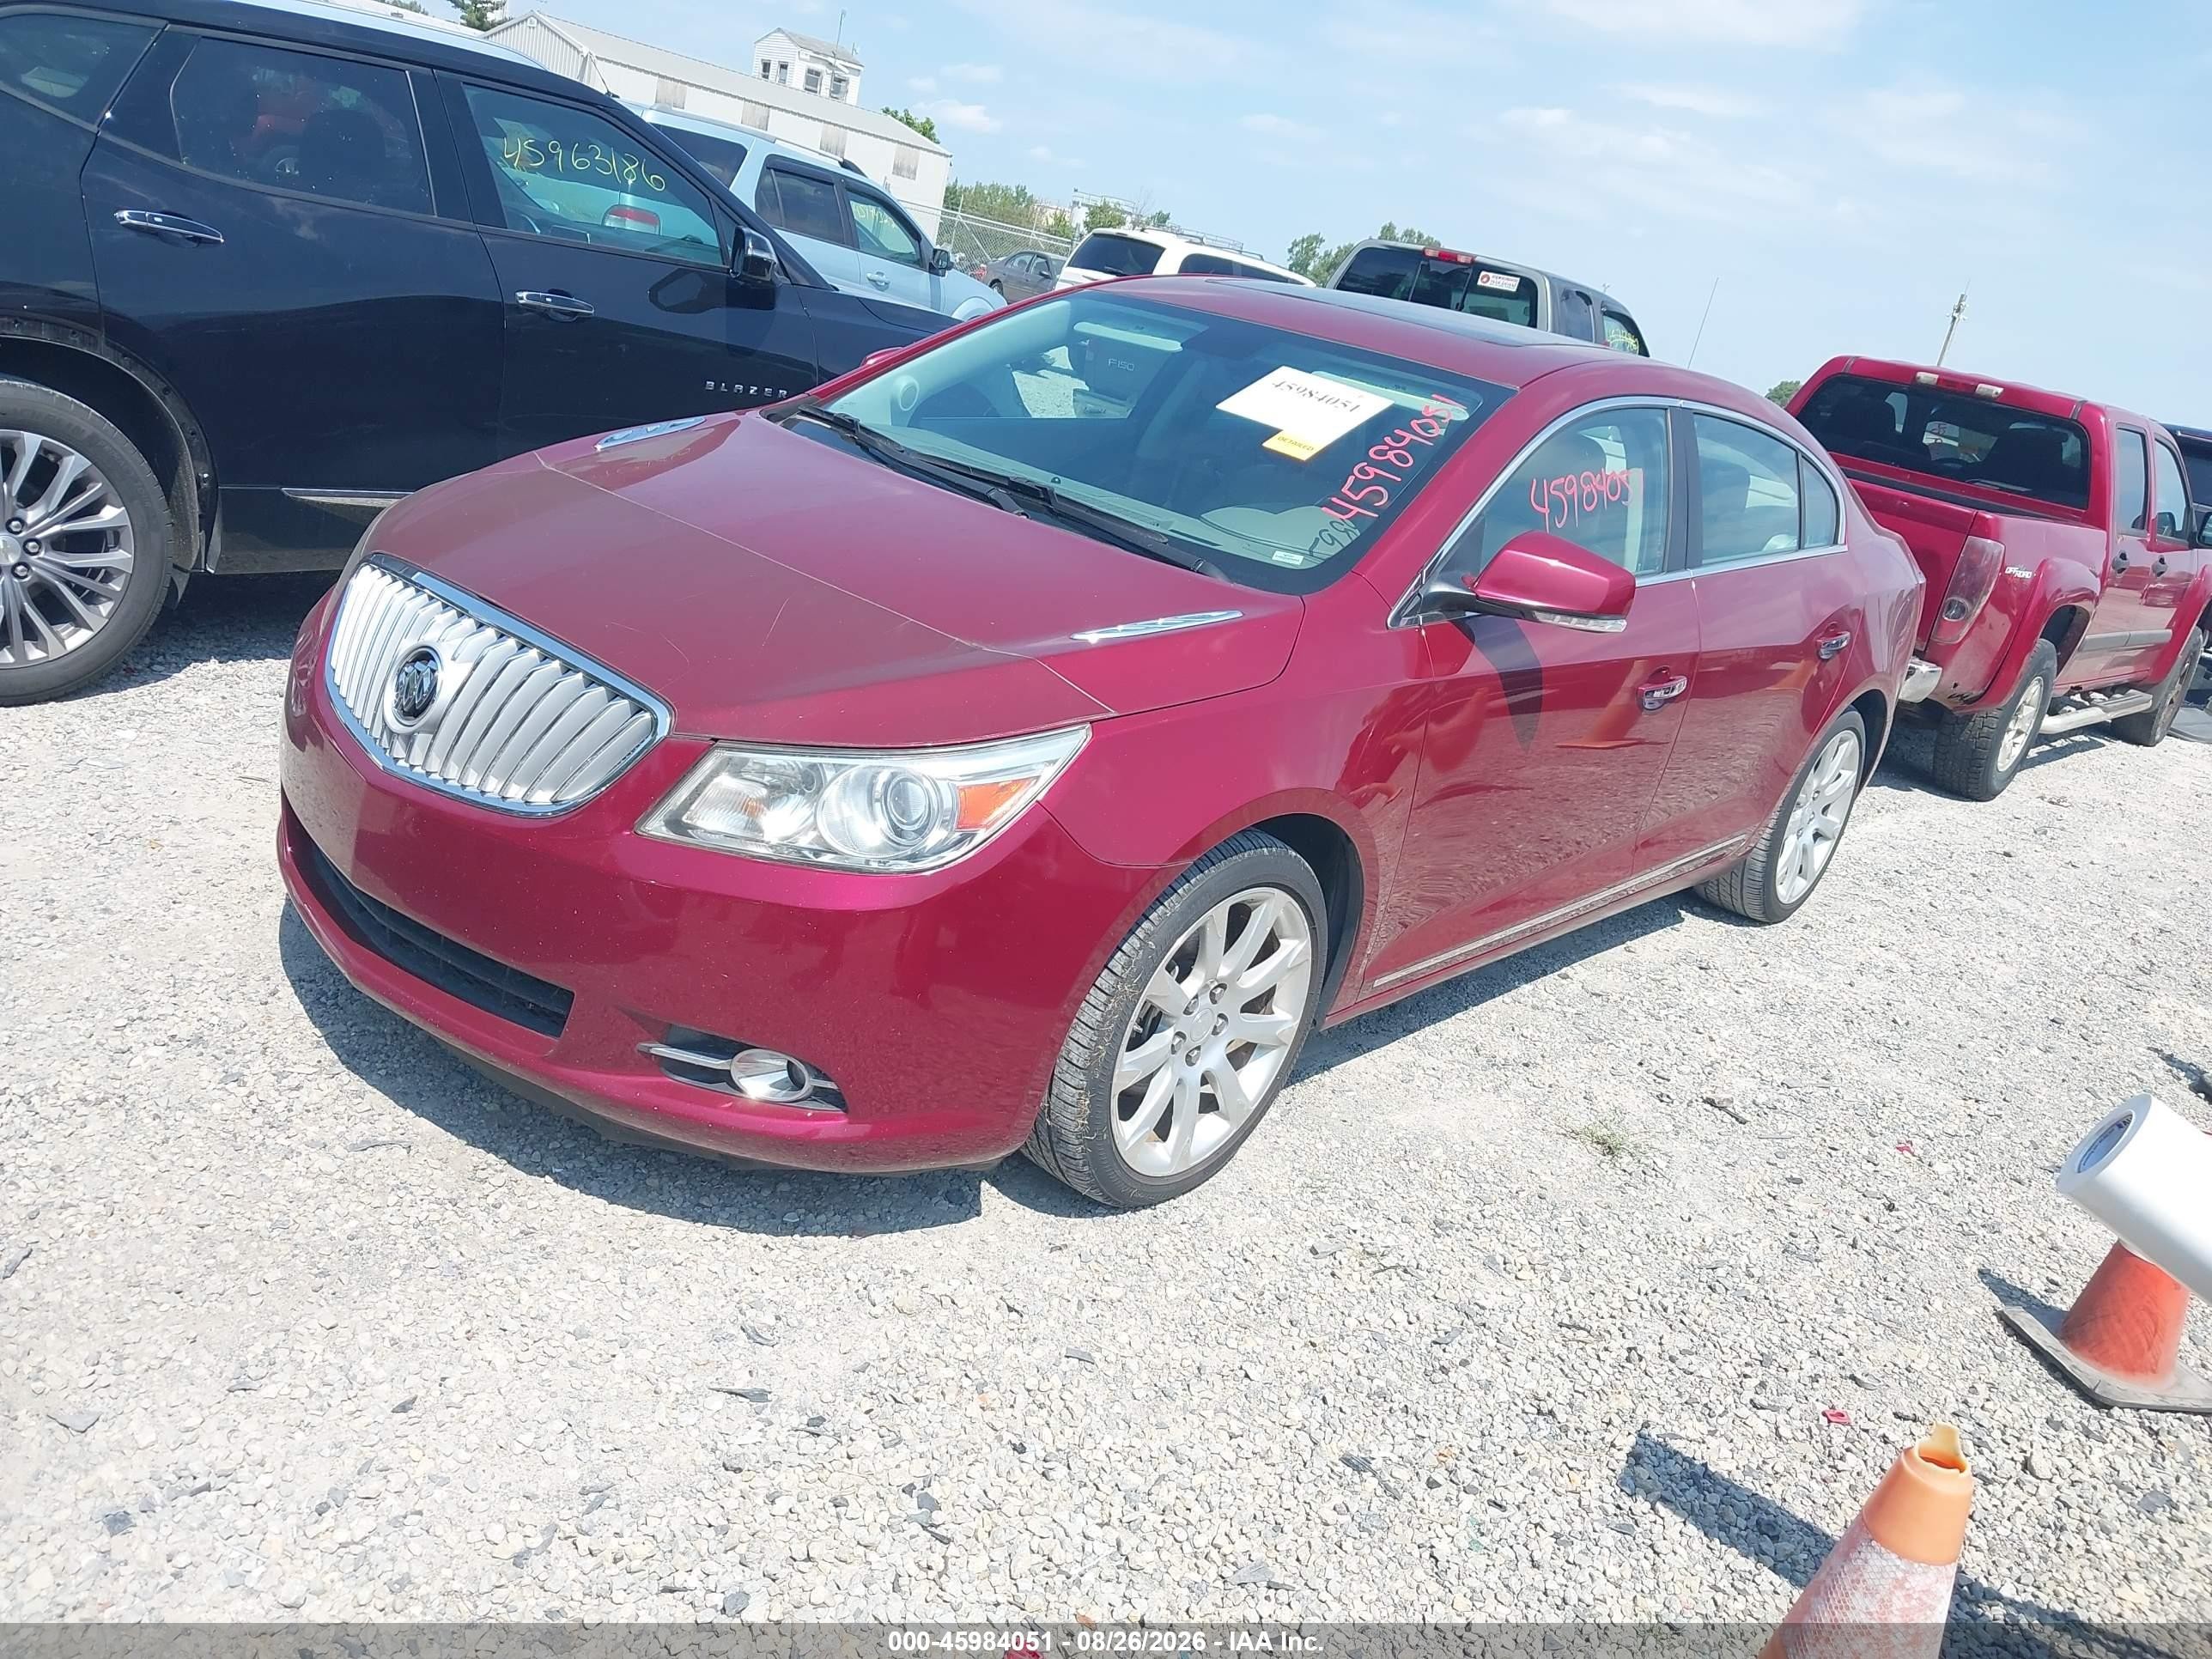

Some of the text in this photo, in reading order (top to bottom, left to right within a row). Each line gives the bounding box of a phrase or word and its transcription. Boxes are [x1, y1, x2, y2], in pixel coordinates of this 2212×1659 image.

[502, 137, 665, 191] 45963186
[1108, 357, 1134, 372] F150
[705, 380, 787, 398] BLAZER
[1277, 435, 1315, 453] DETAILED
[1320, 393, 1468, 519] 45984051
[2004, 566, 2020, 574] OFF
